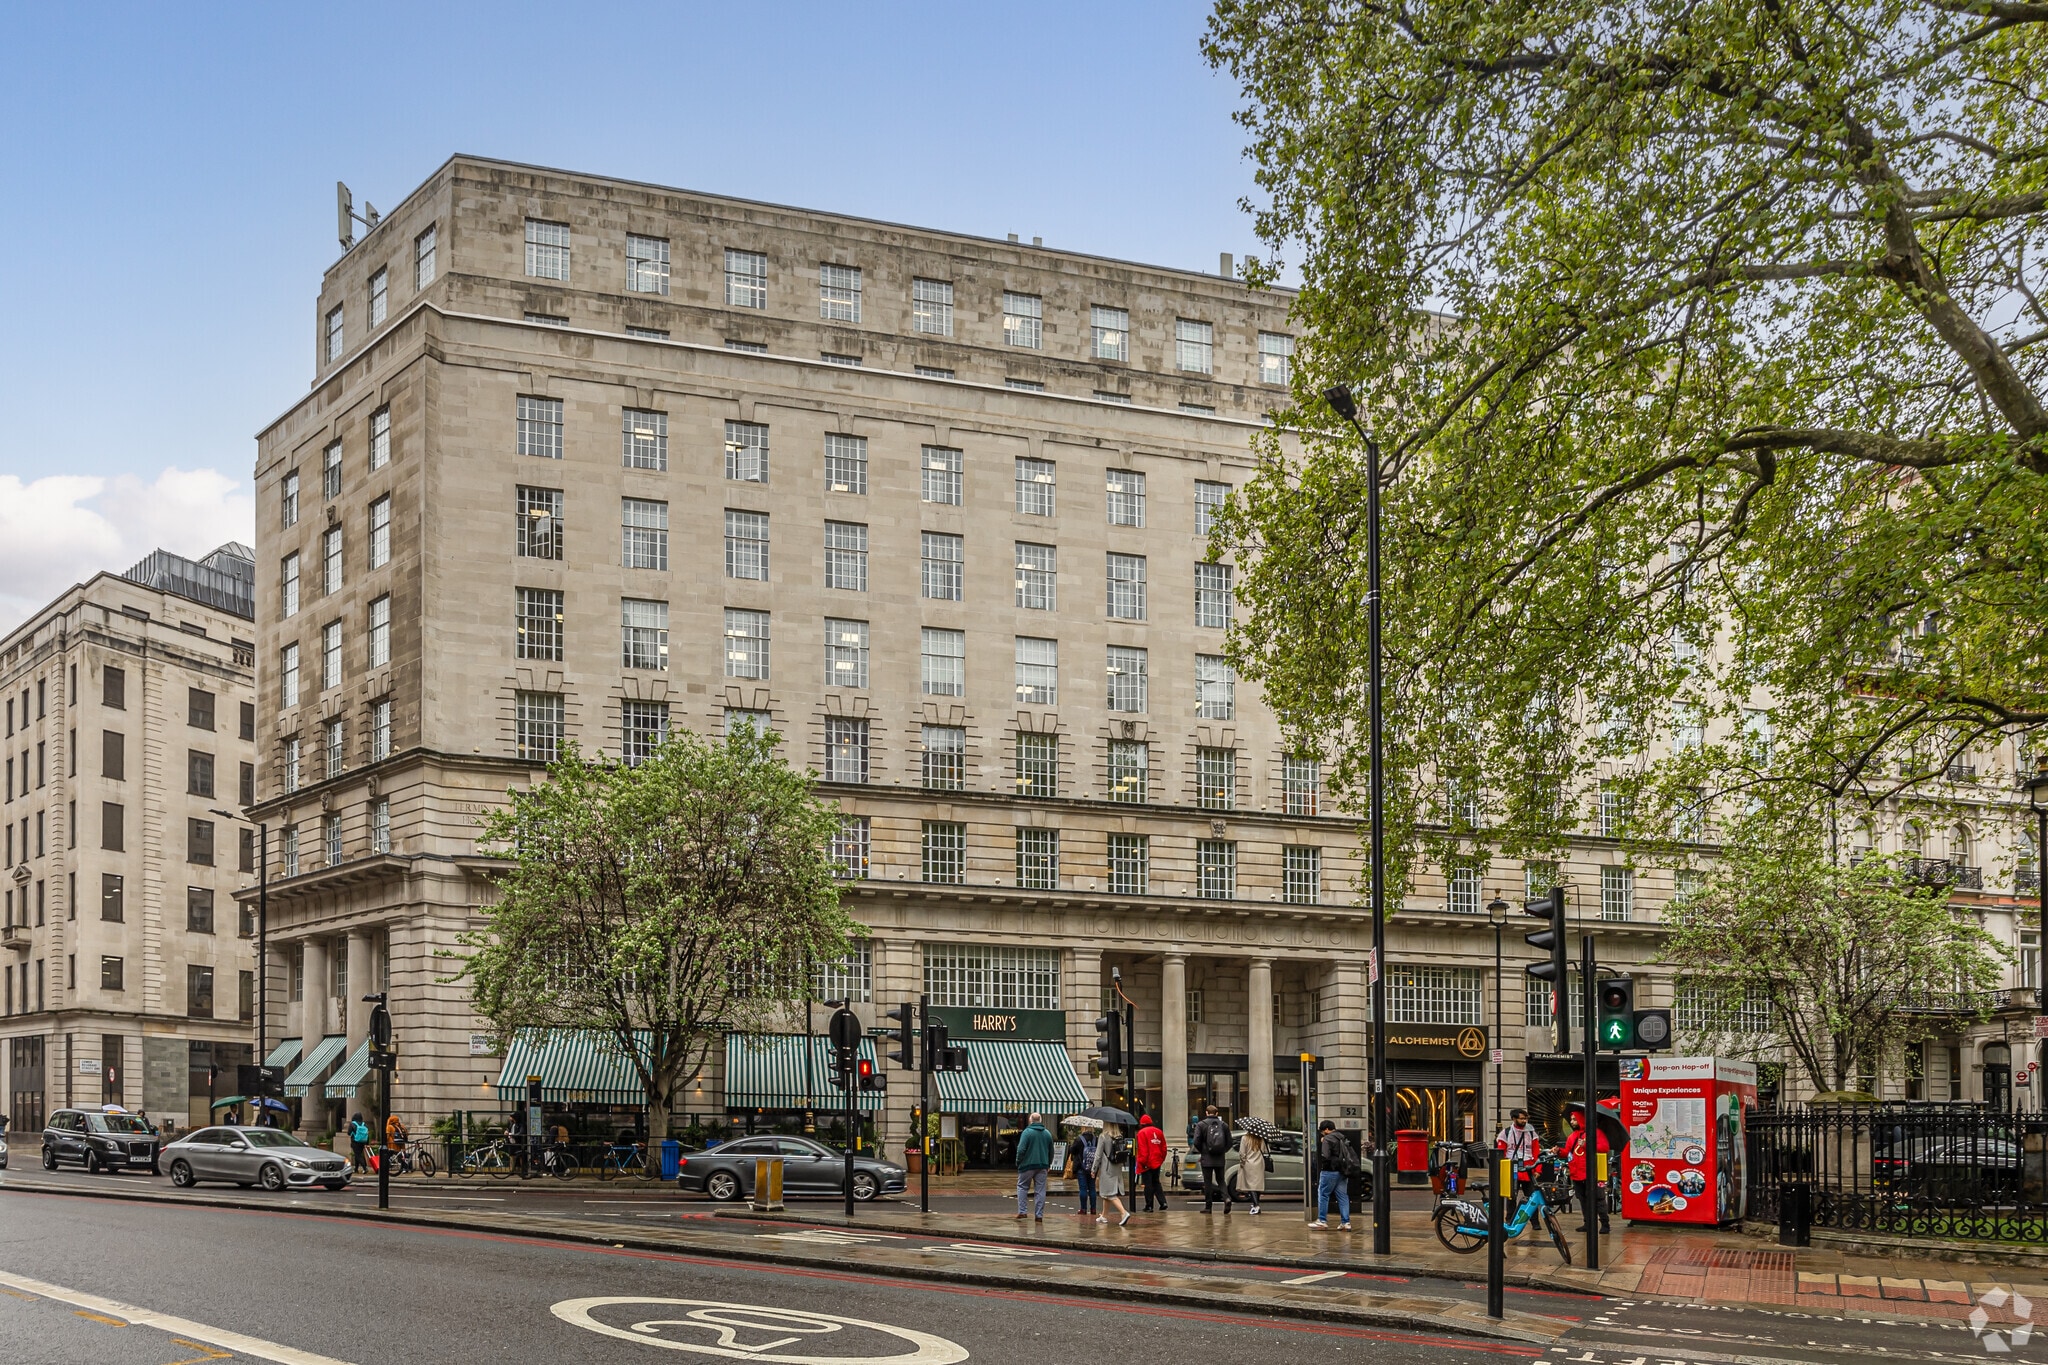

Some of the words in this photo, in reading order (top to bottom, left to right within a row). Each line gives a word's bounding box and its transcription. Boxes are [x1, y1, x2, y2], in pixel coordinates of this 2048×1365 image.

[973, 1014, 1017, 1031] HARRY'S
[1389, 1036, 1457, 1046] ALCHEMIST
[1681, 1063, 1710, 1071] Hop-off
[1658, 1086, 1701, 1094] Experiences
[1346, 1107, 1357, 1115] 52
[629, 1308, 844, 1352] 20
[1637, 1325, 1777, 1342] LOOK
